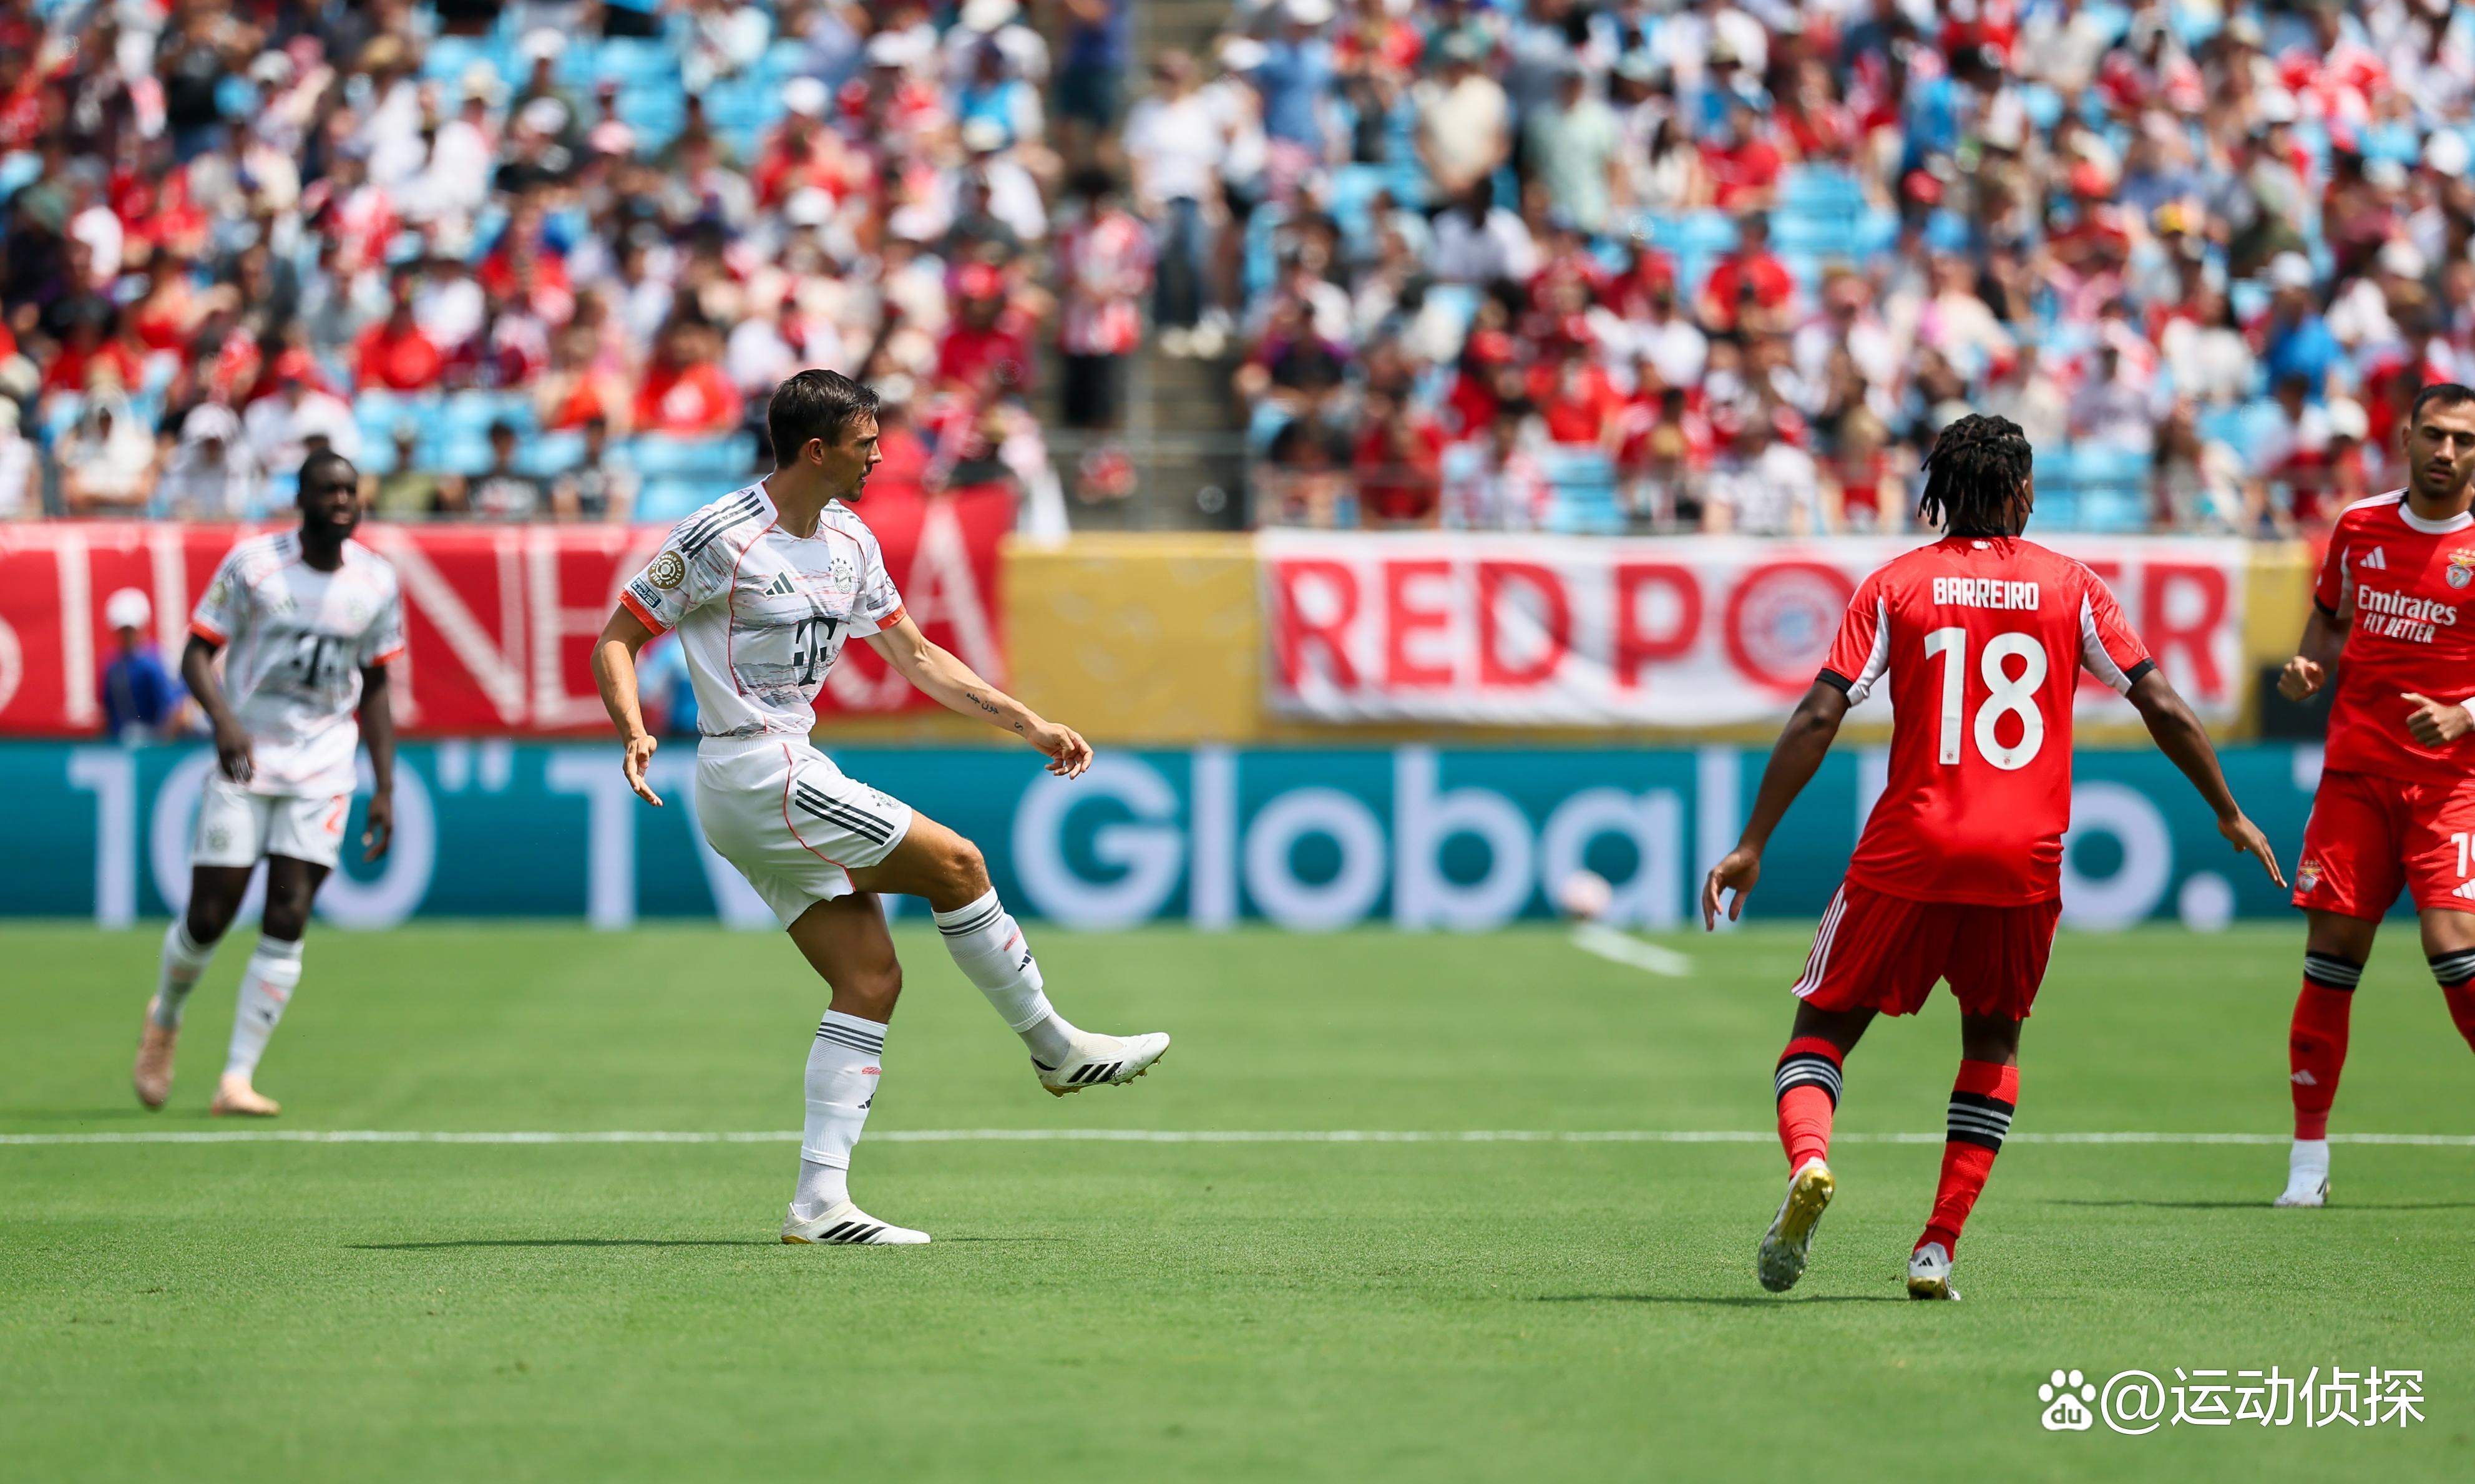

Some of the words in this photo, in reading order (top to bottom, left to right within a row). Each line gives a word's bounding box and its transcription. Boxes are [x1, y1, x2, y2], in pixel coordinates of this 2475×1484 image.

[650, 573, 662, 585] FIFA
[1933, 577, 2039, 611] BARREIRO
[1272, 559, 1571, 691] RED
[2358, 584, 2458, 626] Emirates
[2363, 612, 2386, 634] FLY
[2383, 617, 2436, 643] BETTER
[1924, 627, 2048, 770] 18
[1011, 744, 1742, 931] Global
[2451, 832, 2475, 878] 1
